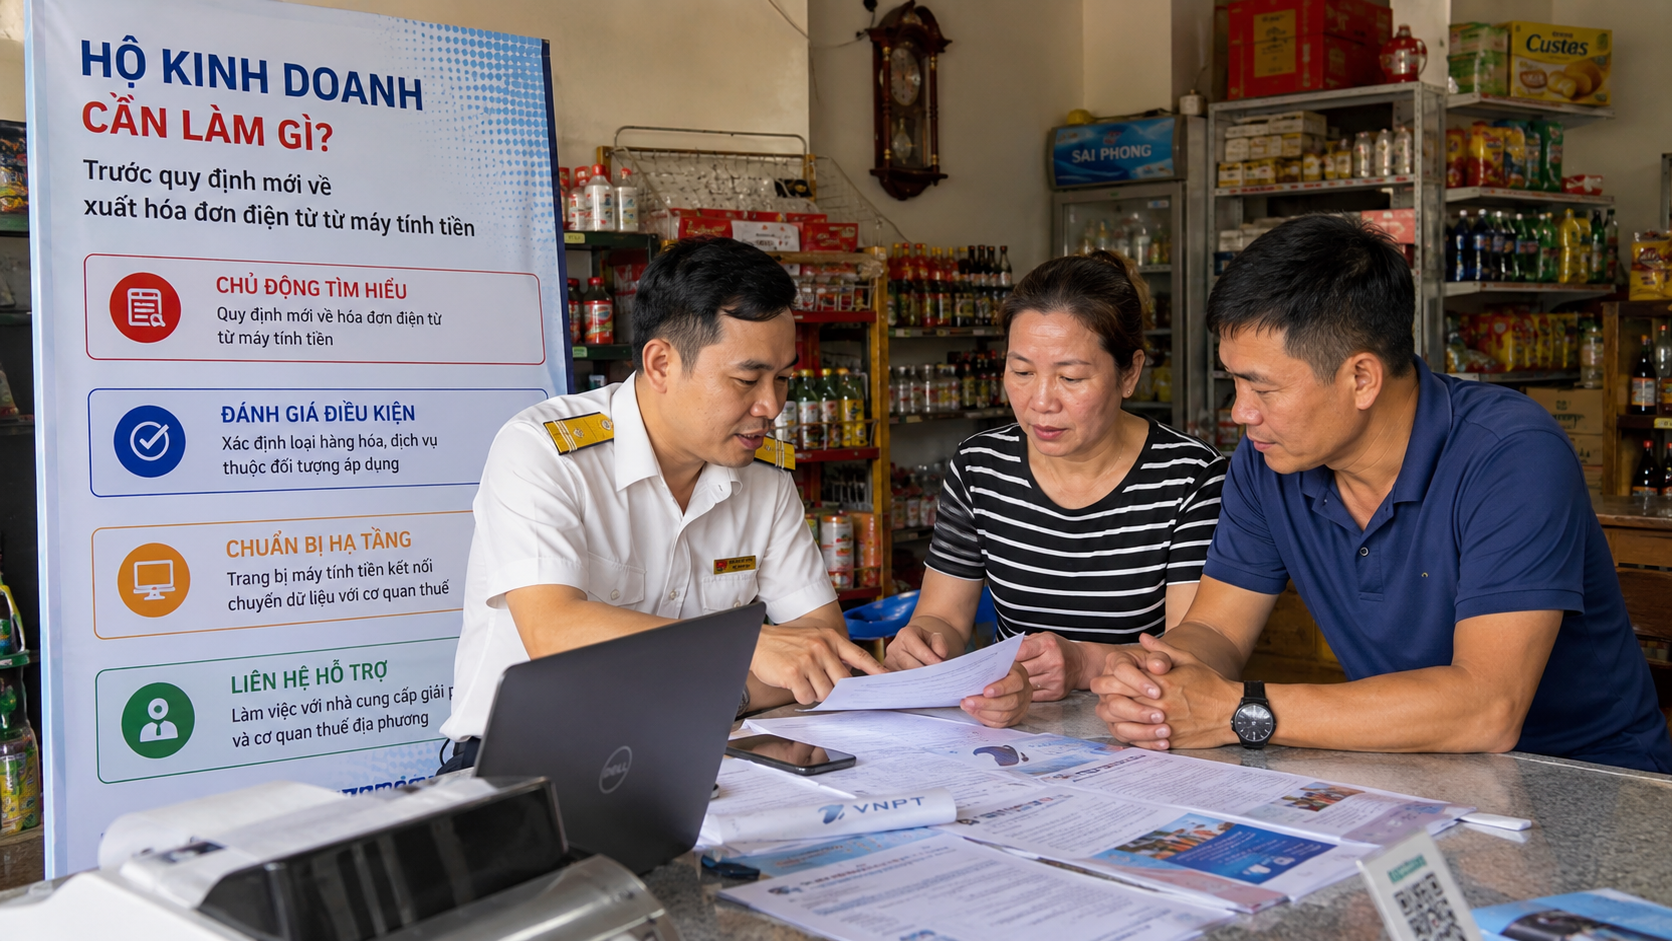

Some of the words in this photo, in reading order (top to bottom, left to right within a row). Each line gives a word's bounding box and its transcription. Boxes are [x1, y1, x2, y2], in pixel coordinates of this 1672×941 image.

[81, 35, 146, 88] HỘ
[162, 49, 268, 93] KINH
[284, 63, 423, 111] DOANH
[82, 92, 167, 138] CẦN
[182, 104, 264, 146] LÀM
[278, 114, 333, 152] GÌ?
[1072, 149, 1095, 164] SAI
[1100, 144, 1152, 161] PHONG
[83, 159, 152, 183] Trước
[159, 170, 201, 191] quy
[208, 168, 255, 193] định
[263, 174, 301, 193] mới
[308, 175, 331, 195] về
[84, 195, 137, 217] xuất
[145, 198, 186, 220] hóa
[195, 201, 236, 223] đơn
[243, 204, 288, 230] điện
[295, 207, 318, 227] từ
[323, 209, 345, 229] từ
[351, 212, 391, 236] máy
[397, 214, 433, 234] tính
[439, 216, 474, 236] tiền
[217, 272, 257, 294] CHỦ
[264, 275, 320, 299] ĐỘNG
[325, 277, 359, 297] TÌM
[365, 278, 406, 299] HIỂU
[217, 307, 246, 324] Quy
[251, 307, 282, 324] định
[287, 308, 312, 322] mới
[317, 308, 333, 323] về
[338, 309, 362, 323] hóa
[367, 311, 392, 324] đơn
[397, 311, 424, 327] điện
[427, 312, 442, 325] từ
[218, 330, 235, 344] từ
[239, 331, 269, 348] máy
[274, 331, 302, 345] tính
[306, 331, 333, 345] tiền
[221, 402, 279, 423] ĐÁNH
[286, 401, 319, 422] GIÁ
[324, 400, 367, 422] ĐIỀU
[374, 401, 415, 425] KIỆN
[222, 436, 249, 450] Xác
[254, 435, 286, 453] định
[291, 435, 315, 451] loại
[320, 434, 354, 451] hàng
[359, 434, 386, 449] hóa,
[391, 433, 418, 447] dịch
[422, 437, 437, 449] vụ
[223, 460, 266, 477] thuộc
[271, 458, 292, 473] đối
[297, 460, 339, 475] tượng
[344, 457, 360, 474] áp
[365, 457, 399, 473] dụng
[226, 530, 298, 558] CHUẨN
[305, 536, 322, 556] BỊ
[330, 534, 356, 554] HẠ
[361, 527, 411, 550] TẦNG
[227, 572, 269, 587] Trang
[275, 568, 287, 586] bị
[293, 566, 322, 584] máy
[326, 564, 353, 579] tính
[358, 562, 384, 577] tiền
[388, 560, 409, 575] kết
[413, 558, 432, 573] nối
[287, 592, 306, 606] dữ
[310, 590, 334, 607] liệu
[339, 588, 358, 602] với
[363, 588, 379, 600] cơ
[383, 587, 415, 602] quan
[419, 579, 449, 596] thuế
[232, 670, 276, 694] LIÊN
[284, 665, 309, 691] HỆ
[316, 659, 343, 685] HỖ
[349, 660, 387, 682] TRỢ
[232, 707, 263, 722] Làm
[268, 702, 297, 720] việc
[301, 699, 321, 714] với
[327, 695, 352, 711] nhà
[357, 695, 389, 708] cung
[394, 687, 417, 705] cấp
[233, 732, 249, 747] và
[255, 731, 272, 745] cơ
[276, 728, 312, 745] quan
[316, 718, 349, 737] thuế
[353, 717, 373, 734] địa
[378, 714, 428, 732] phương
[853, 796, 925, 814] VNPT
